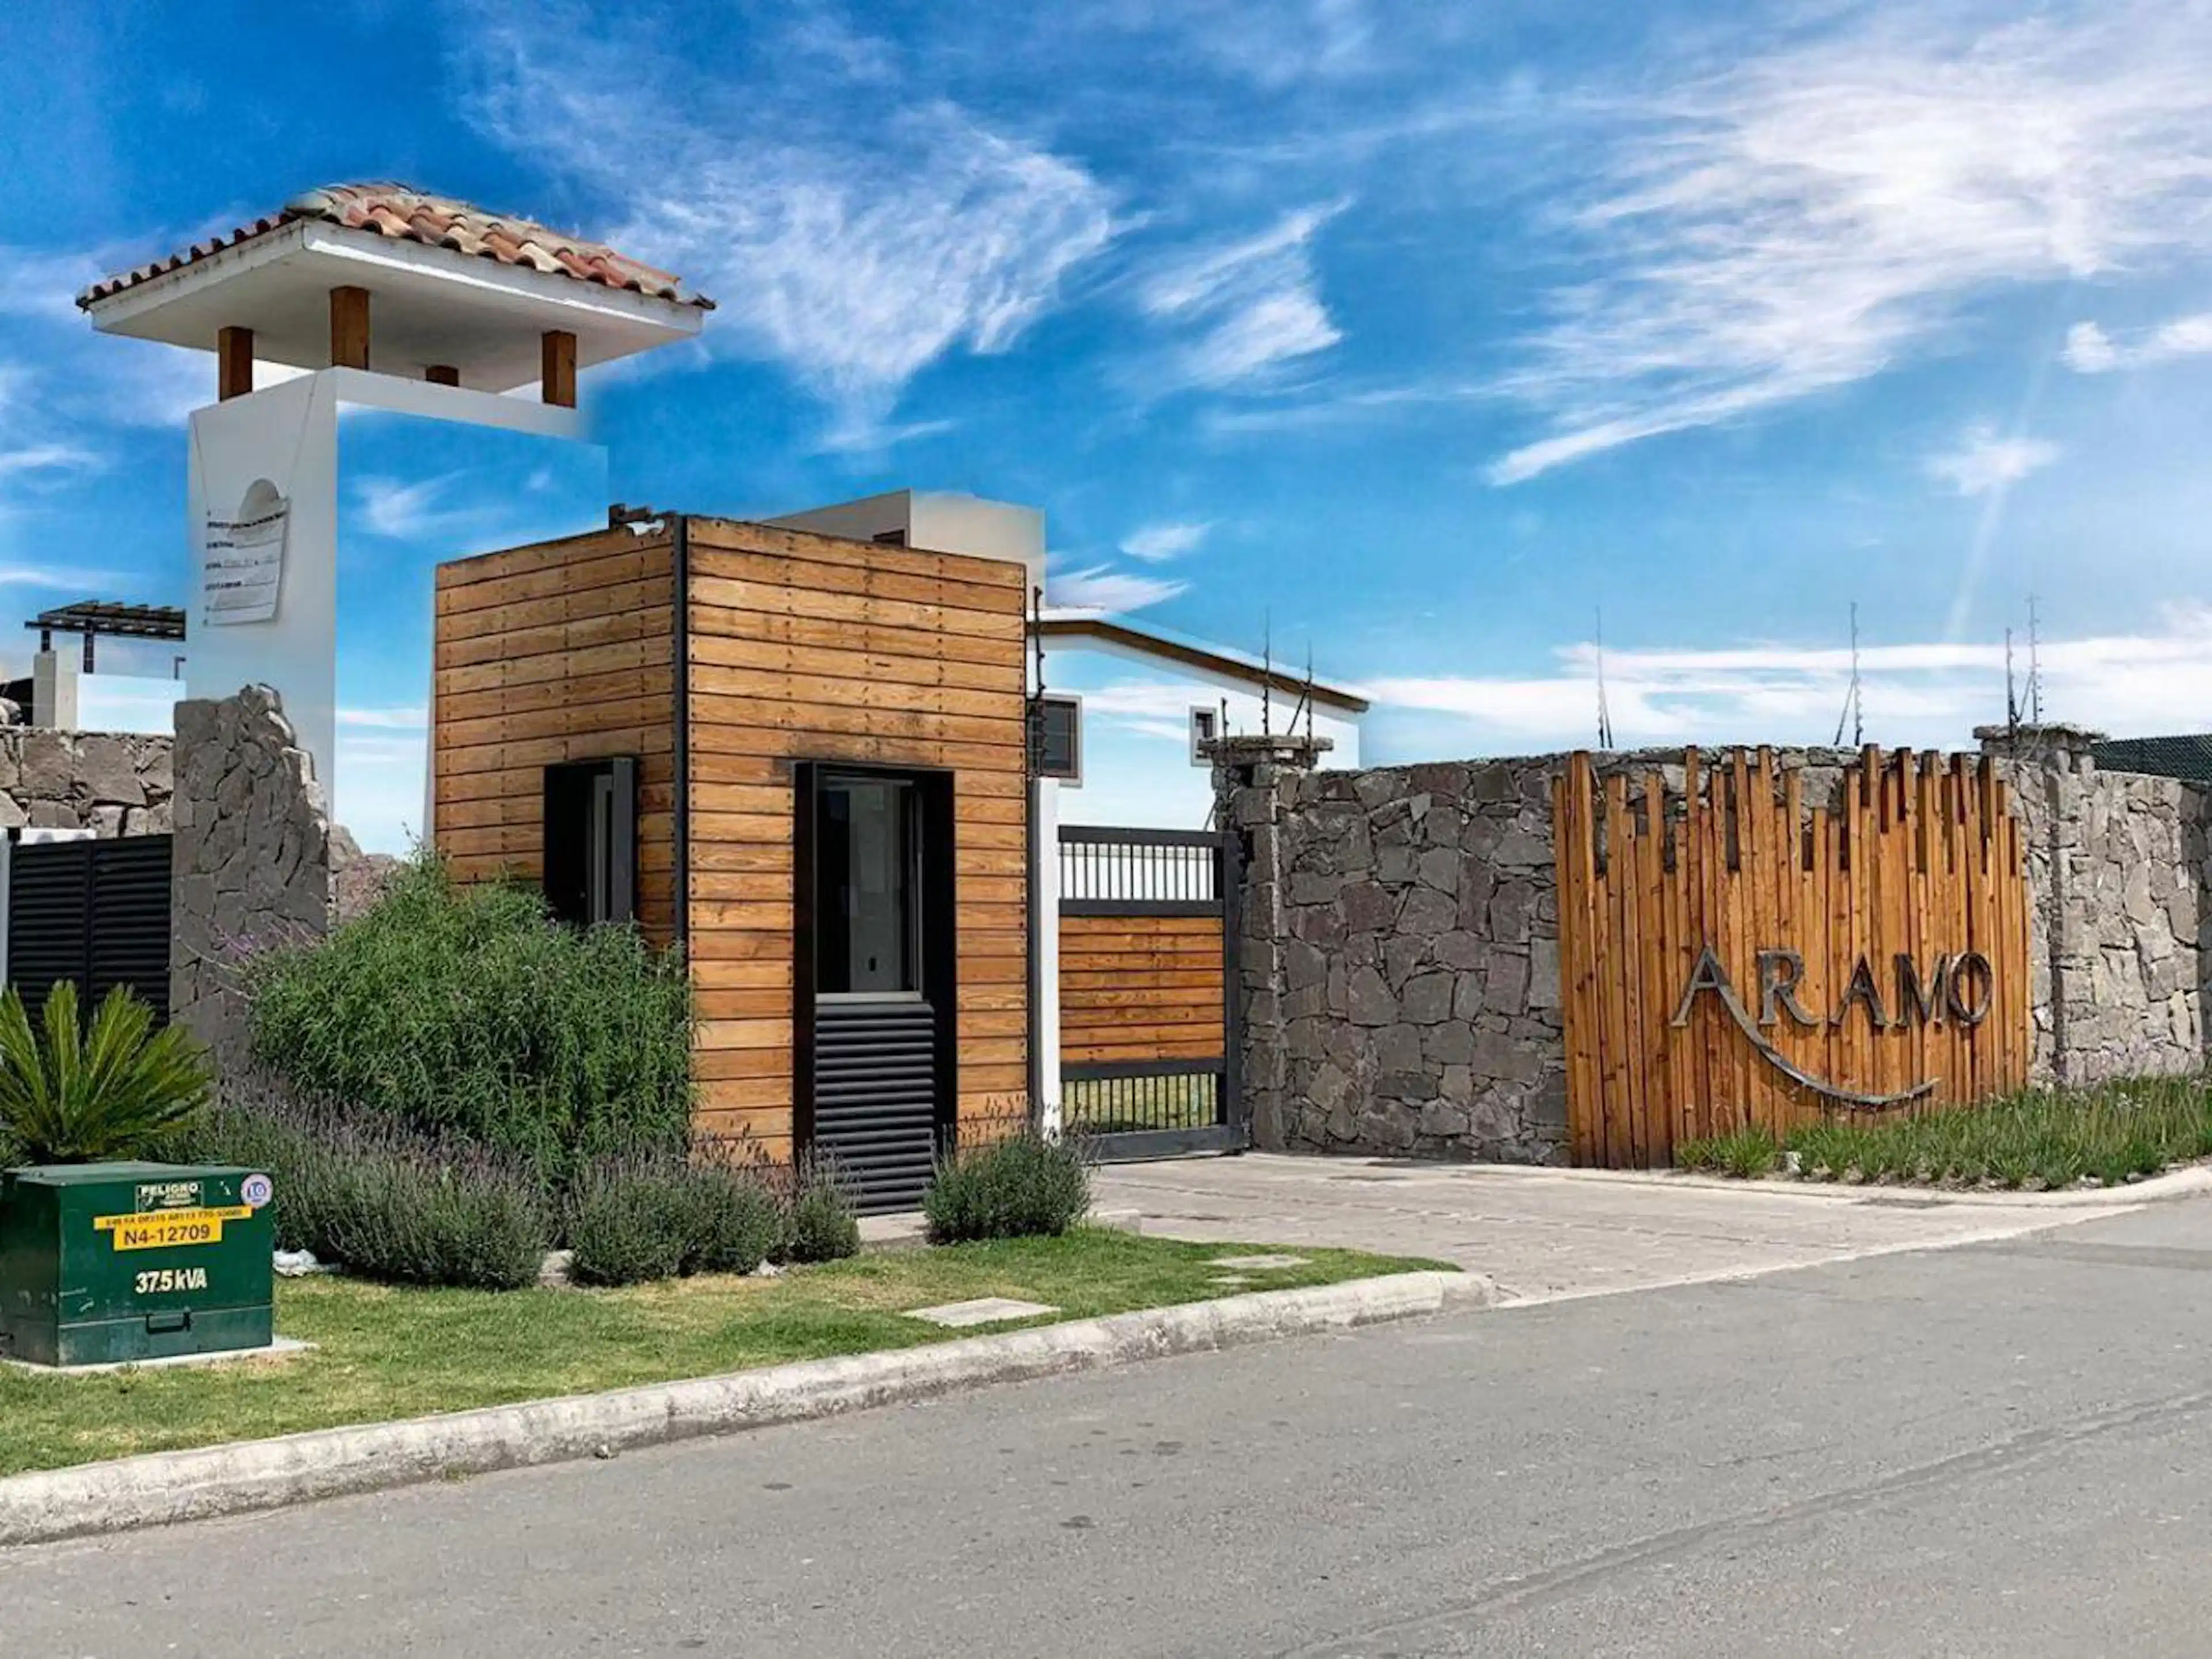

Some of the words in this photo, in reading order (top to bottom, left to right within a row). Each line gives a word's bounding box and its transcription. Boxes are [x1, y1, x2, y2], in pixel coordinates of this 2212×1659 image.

[1670, 942, 1993, 1112] ARAMO
[141, 1182, 199, 1196] PELIGRO
[123, 1224, 211, 1246] N4-12709
